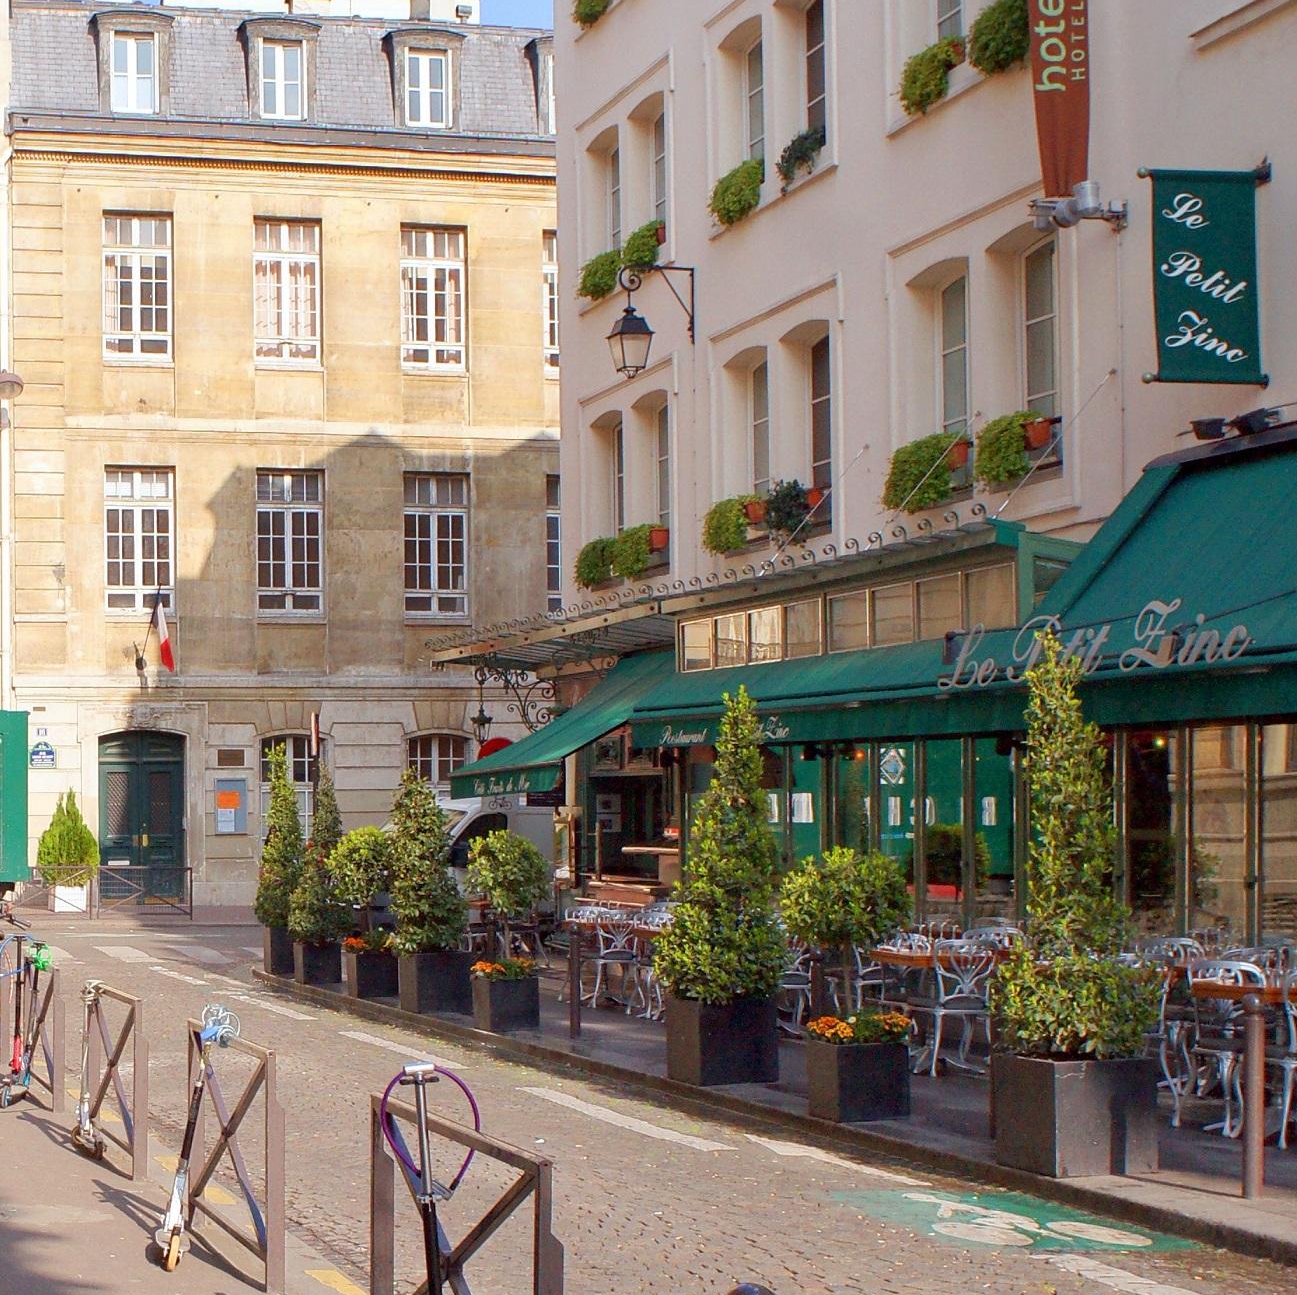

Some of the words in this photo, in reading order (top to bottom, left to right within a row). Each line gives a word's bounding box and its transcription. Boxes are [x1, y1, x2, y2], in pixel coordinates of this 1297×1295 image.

[1161, 192, 1210, 229] Le
[1160, 251, 1248, 304] Petit
[1164, 309, 1249, 363] Zinc
[938, 623, 997, 691] Le
[1006, 613, 1111, 683] Ptit
[1119, 598, 1256, 672] Zinc
